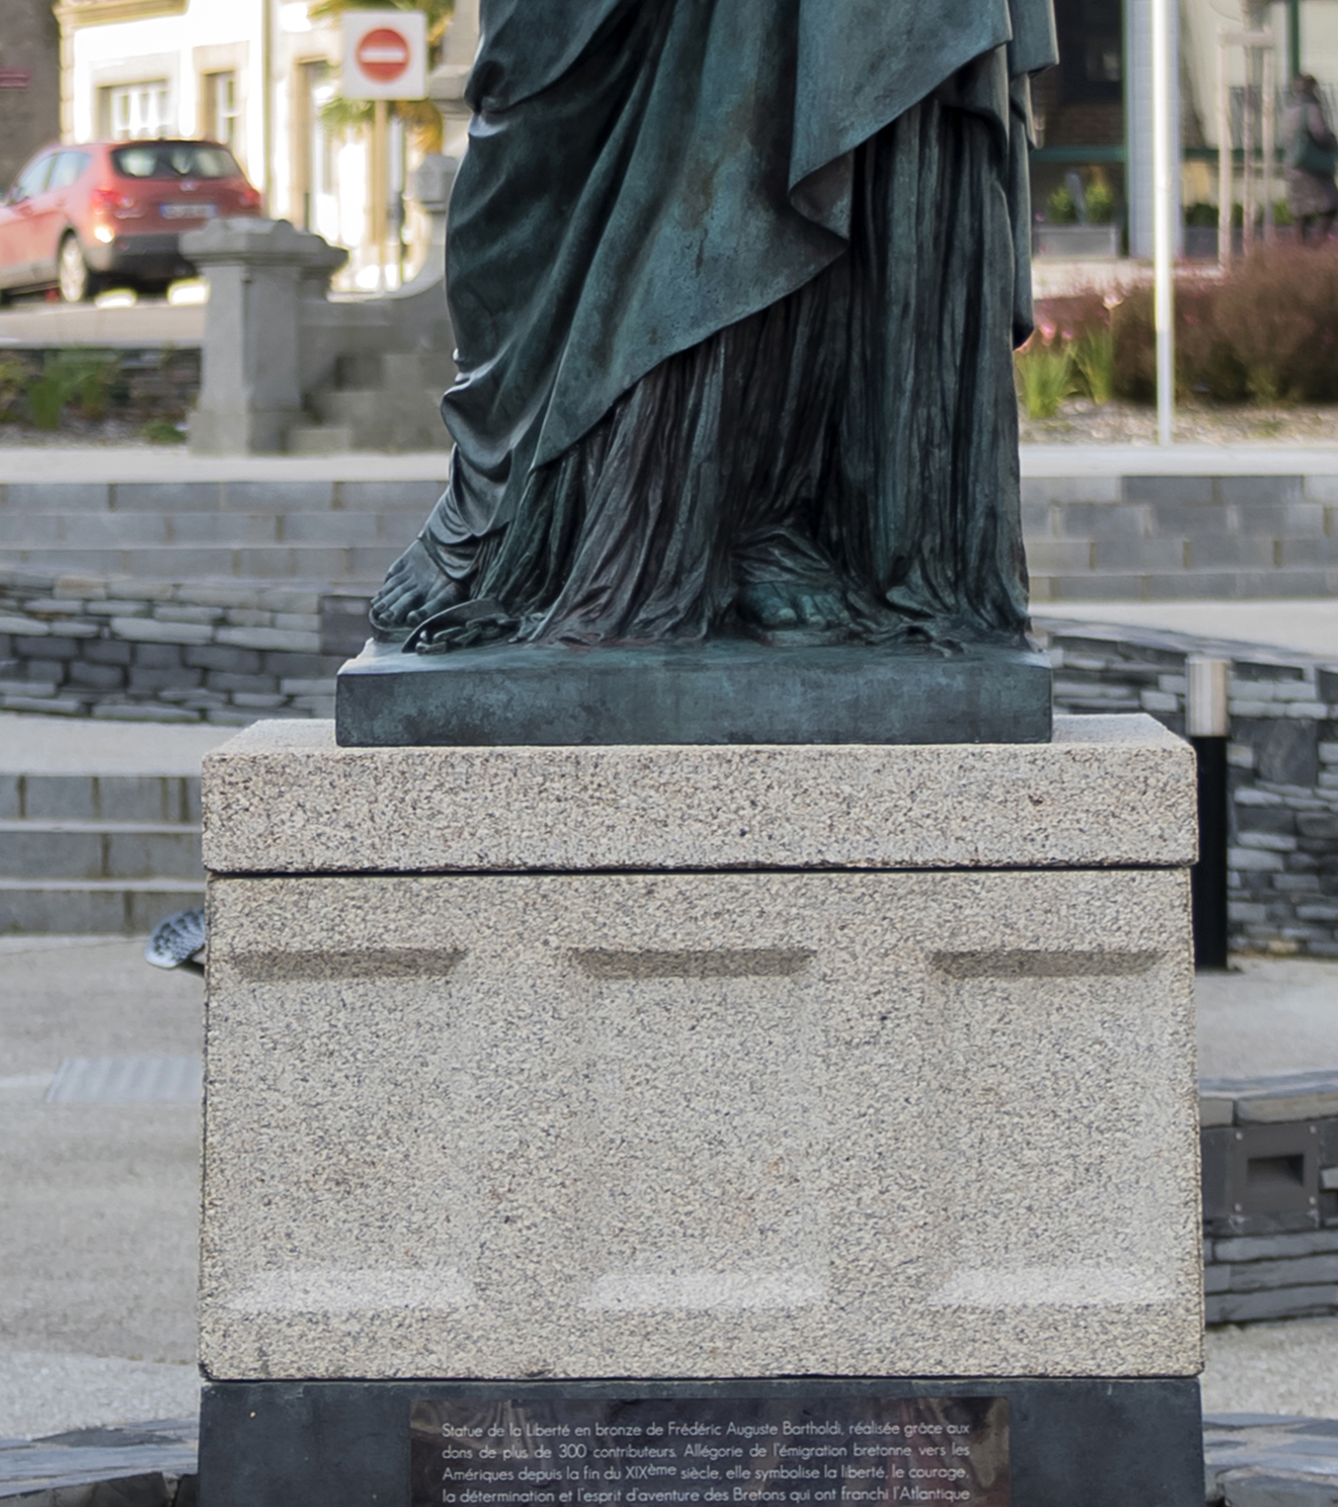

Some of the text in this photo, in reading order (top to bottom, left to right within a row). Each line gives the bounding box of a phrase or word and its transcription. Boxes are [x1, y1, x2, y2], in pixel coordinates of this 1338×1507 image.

[442, 1420, 970, 1439] Statue de la Liberté en bronze de Frédéric Auguste Bartholdi, réalisée grâce aux
[442, 1442, 970, 1462] dons de plus de 300 contributeurs. Allégorie de l'émigration bretonne vers les
[442, 1464, 970, 1484] Amériques depuis la fin du XIXème siècle, elle symbolise la liberté, le courage,
[443, 1486, 971, 1505] la détermination et l'esprit d'aventure des Bretons qui ont franchi l'Atlantique
